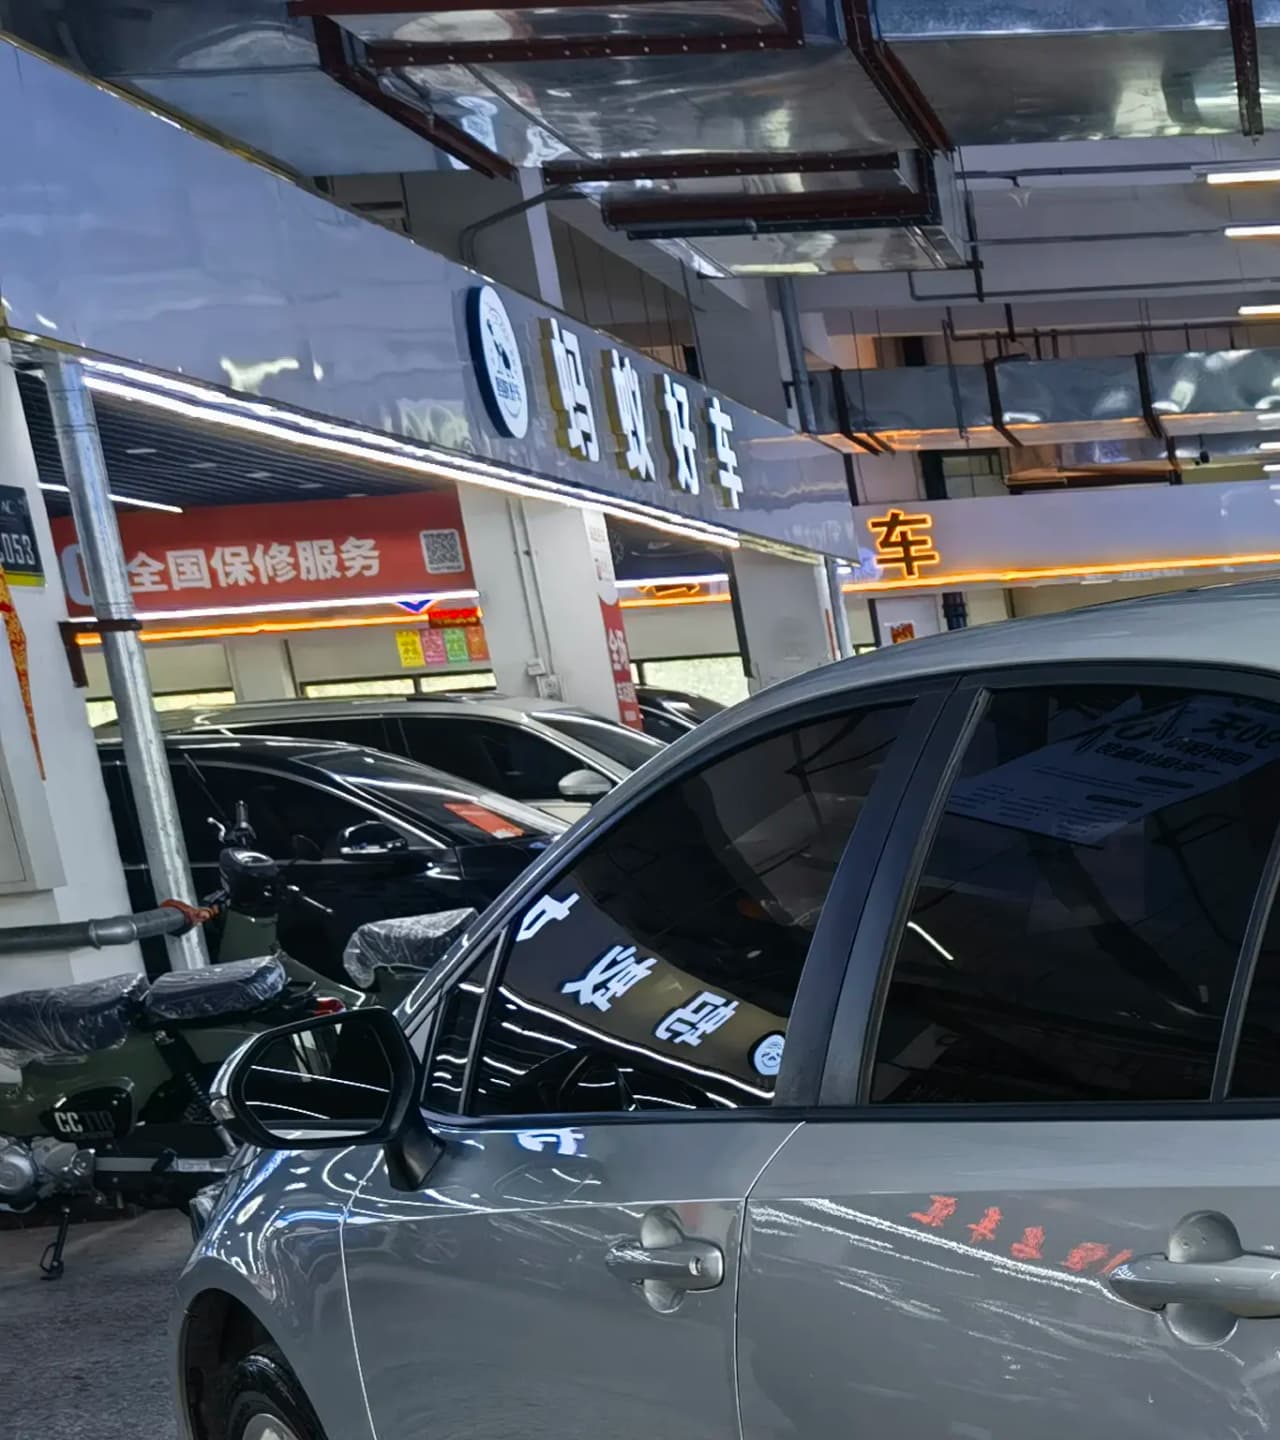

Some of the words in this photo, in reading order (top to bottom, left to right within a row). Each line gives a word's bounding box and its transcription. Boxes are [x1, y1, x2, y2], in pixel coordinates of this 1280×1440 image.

[550, 317, 745, 510] 蚂蚁好车
[126, 536, 381, 594] 全国保修服务
[867, 508, 940, 580] 车
